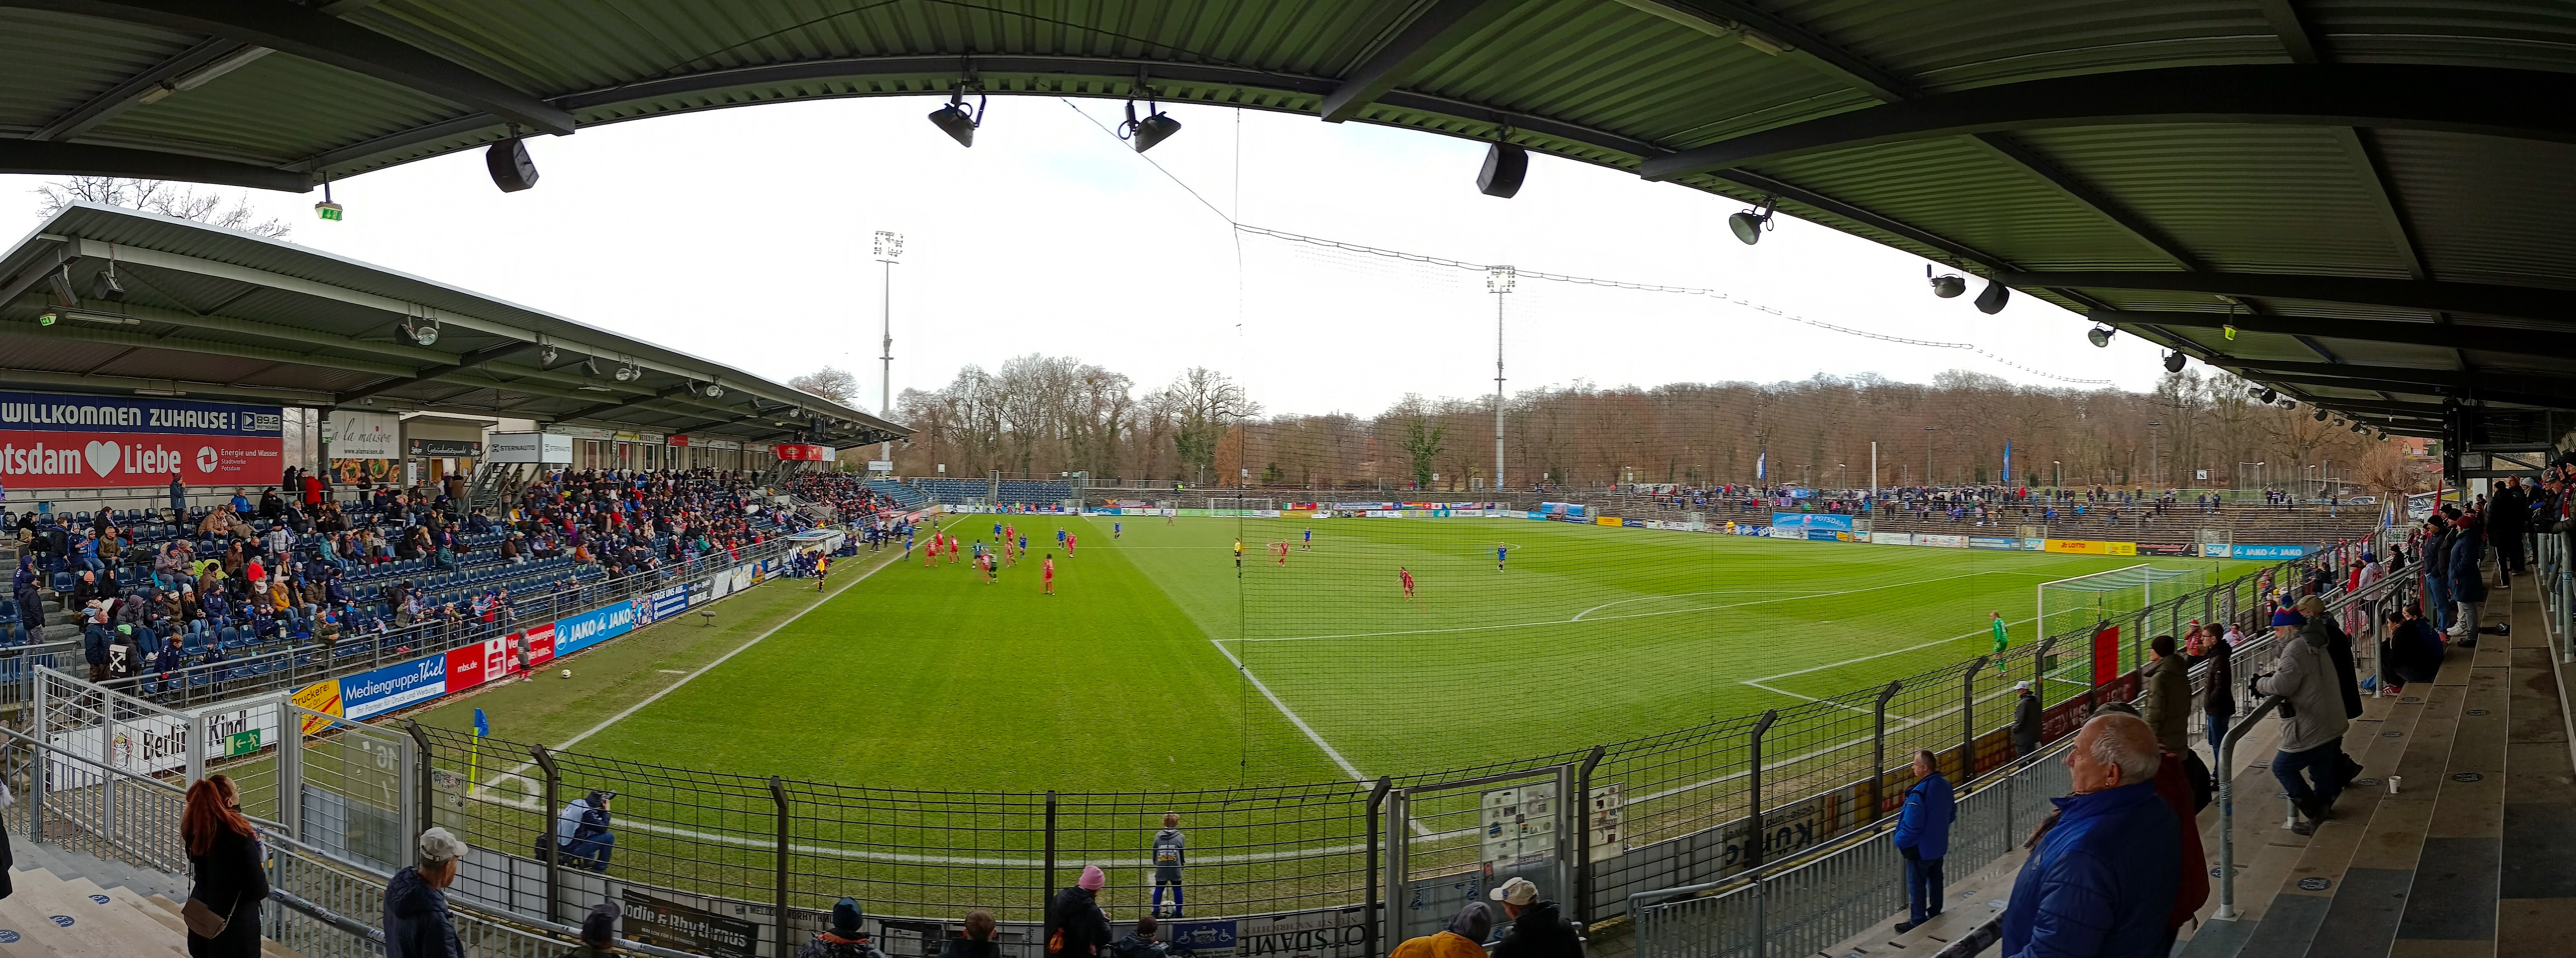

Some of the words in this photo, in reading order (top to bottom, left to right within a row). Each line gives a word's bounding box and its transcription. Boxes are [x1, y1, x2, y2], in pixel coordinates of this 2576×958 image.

[2, 403, 141, 426] WILLKOMMEN
[257, 416, 278, 424] 89.2
[344, 418, 354, 441] la
[0, 442, 81, 475] tsdam
[125, 444, 181, 474] Liebe
[221, 449, 244, 458] Energie
[2207, 545, 2223, 554] SAP
[2279, 548, 2303, 557] JAKO
[652, 590, 665, 602] FOLGE
[666, 587, 675, 597] UNS
[608, 608, 631, 629] JAKO
[570, 619, 596, 642] JAKO
[457, 660, 478, 673] mbs.de
[345, 673, 419, 701] Mediengruppe
[418, 656, 445, 683] Thiel
[356, 704, 365, 714] Ihr
[365, 702, 383, 713] Partner
[392, 695, 405, 704] Druck
[407, 692, 416, 701] und
[416, 686, 437, 698] Werbung
[669, 914, 748, 947] Rhythmus
[1243, 923, 1313, 934] NACHRICHTEN
